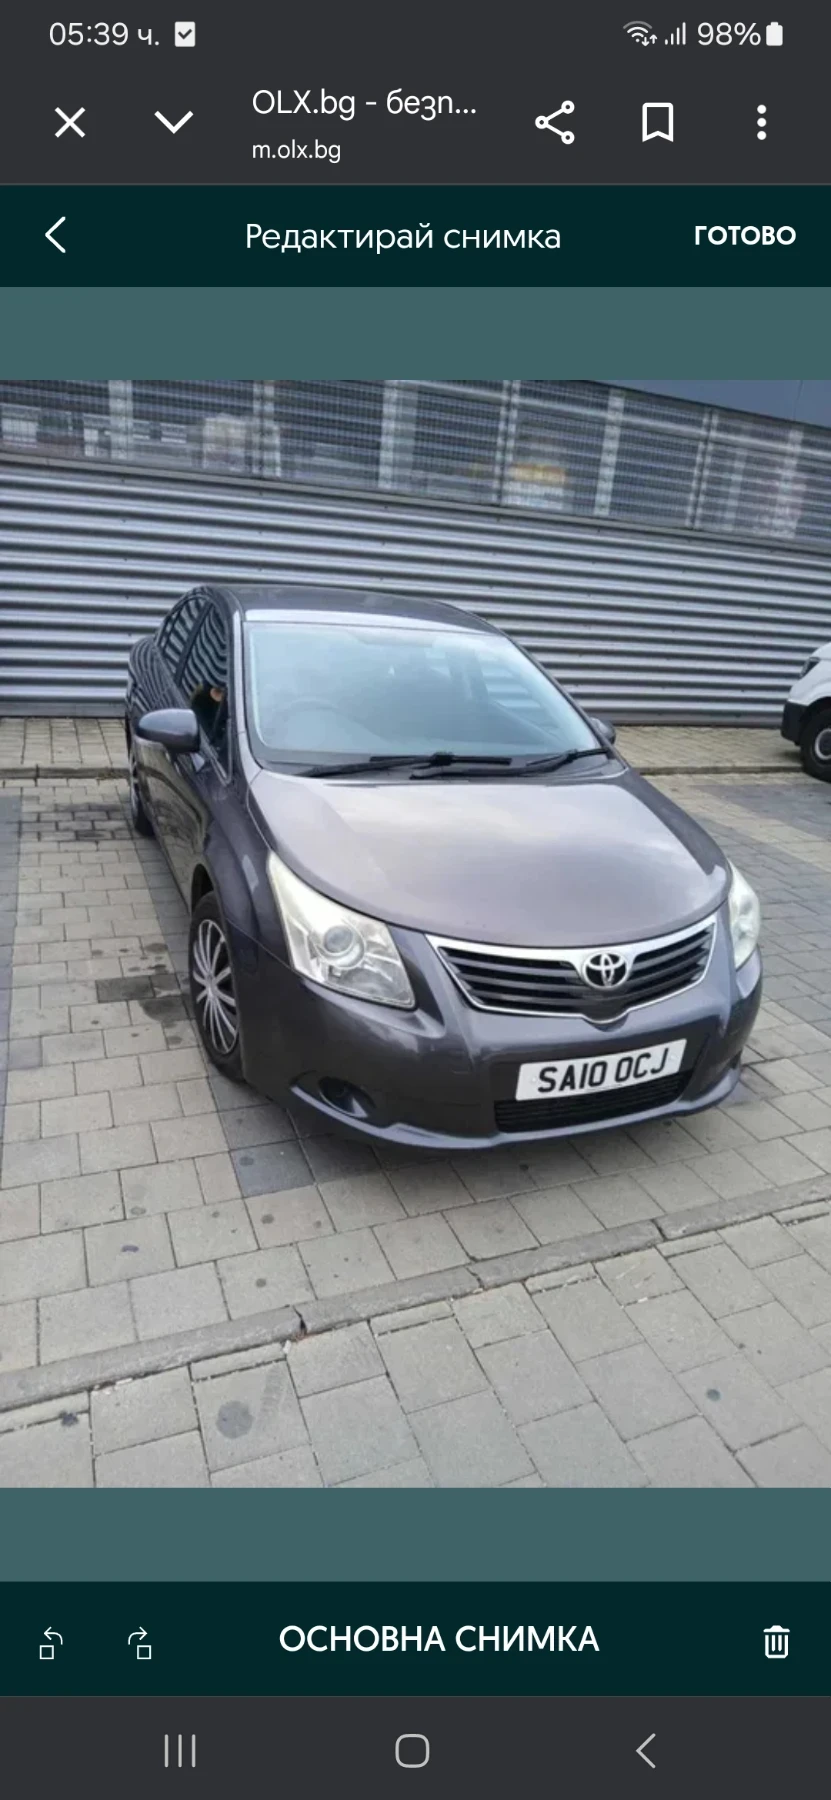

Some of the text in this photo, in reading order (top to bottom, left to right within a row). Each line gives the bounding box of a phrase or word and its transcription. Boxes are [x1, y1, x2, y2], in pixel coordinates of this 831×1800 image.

[49, 21, 160, 46] 05:39 ч.
[697, 21, 762, 46] 98%
[252, 87, 356, 122] OLX.bg
[252, 138, 341, 164] m.olx.bg
[246, 222, 561, 255] Редактирай снимка
[695, 225, 797, 246] ГОТОВО
[537, 1047, 670, 1094] SA10 OCJ
[279, 1625, 600, 1652] ОСНОВНА СНИМКА
